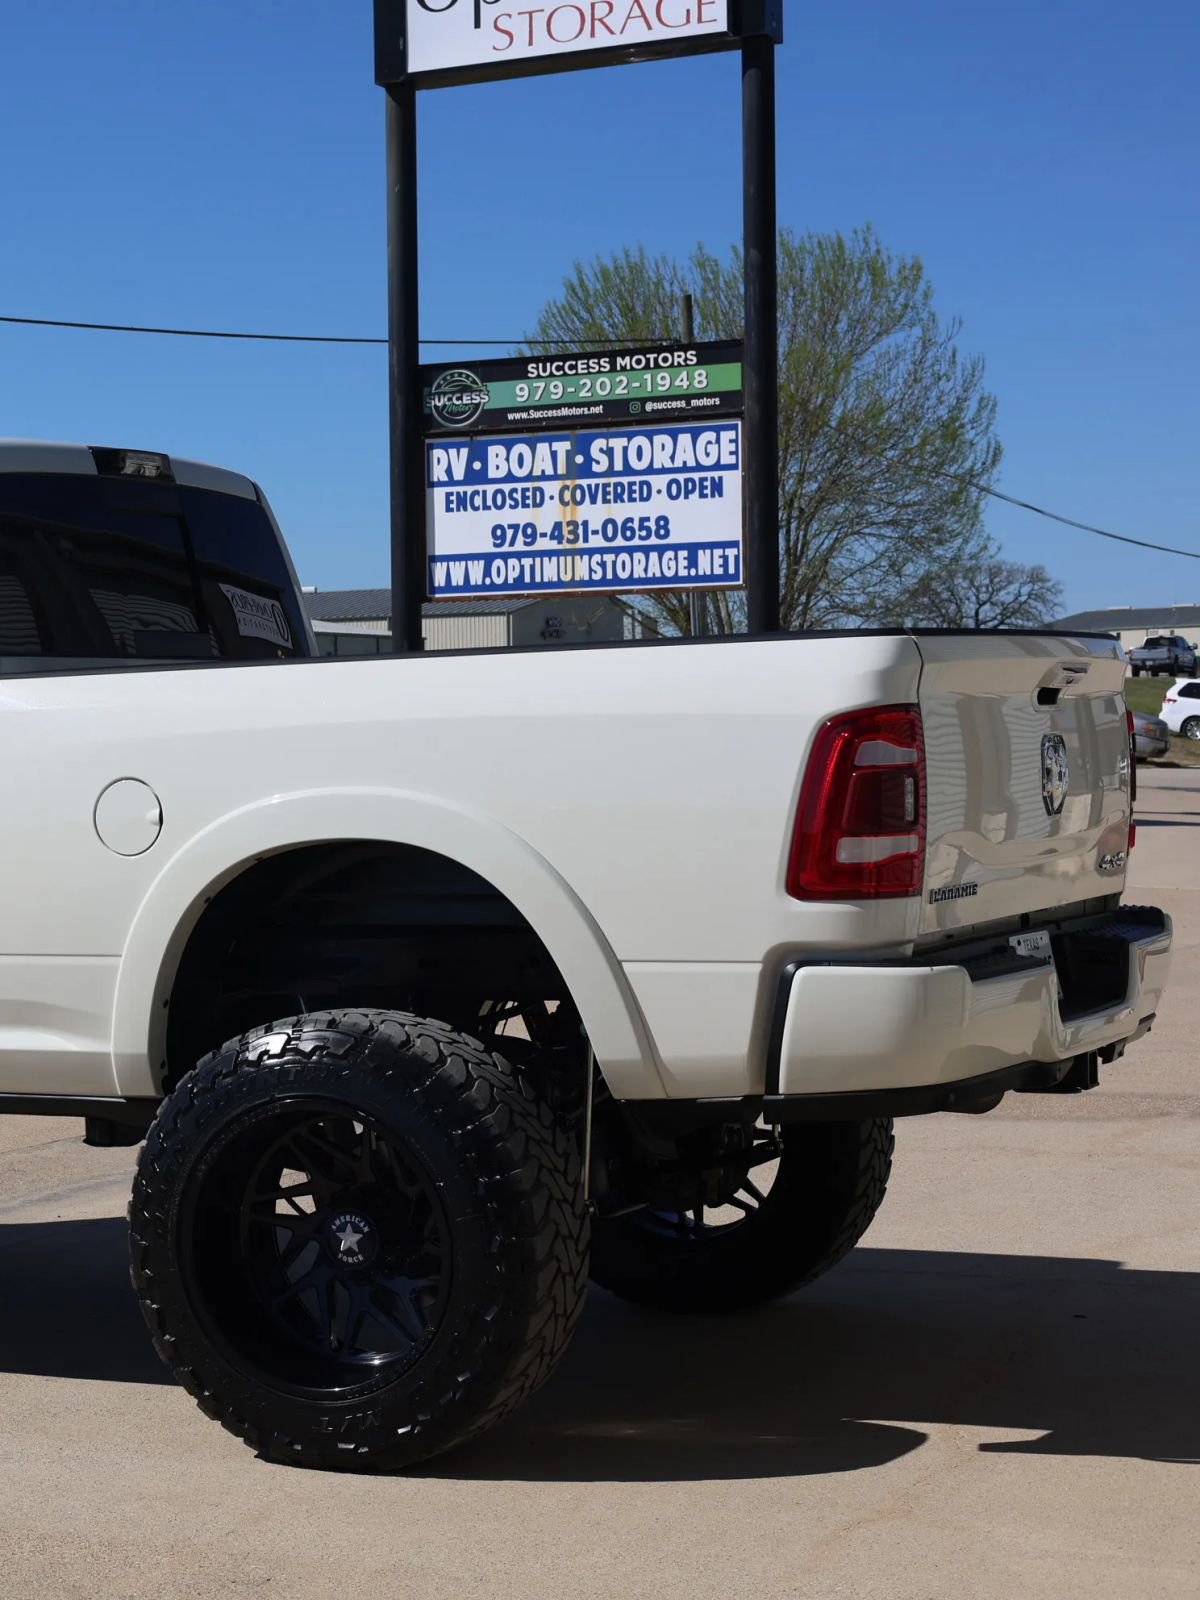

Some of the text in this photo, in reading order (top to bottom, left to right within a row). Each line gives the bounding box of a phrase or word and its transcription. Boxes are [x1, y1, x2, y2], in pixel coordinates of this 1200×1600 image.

[492, 0, 718, 51] STORAGE
[527, 350, 698, 378] SUCCESS MOTORS
[515, 369, 709, 402] 979-202-1948
[507, 404, 604, 421] www.SuccessMotors.net
[644, 397, 720, 413] @success_motors
[432, 430, 737, 482] RV BOAT STORAGE
[444, 475, 724, 513] ENCLOSED COVERED OPEN
[490, 515, 671, 548] 979-431-0658
[432, 548, 738, 587] WWW.OPTIMUMSTORAGE.NET
[330, 1214, 371, 1233] AMERICAN
[337, 1251, 364, 1264] FORCE
